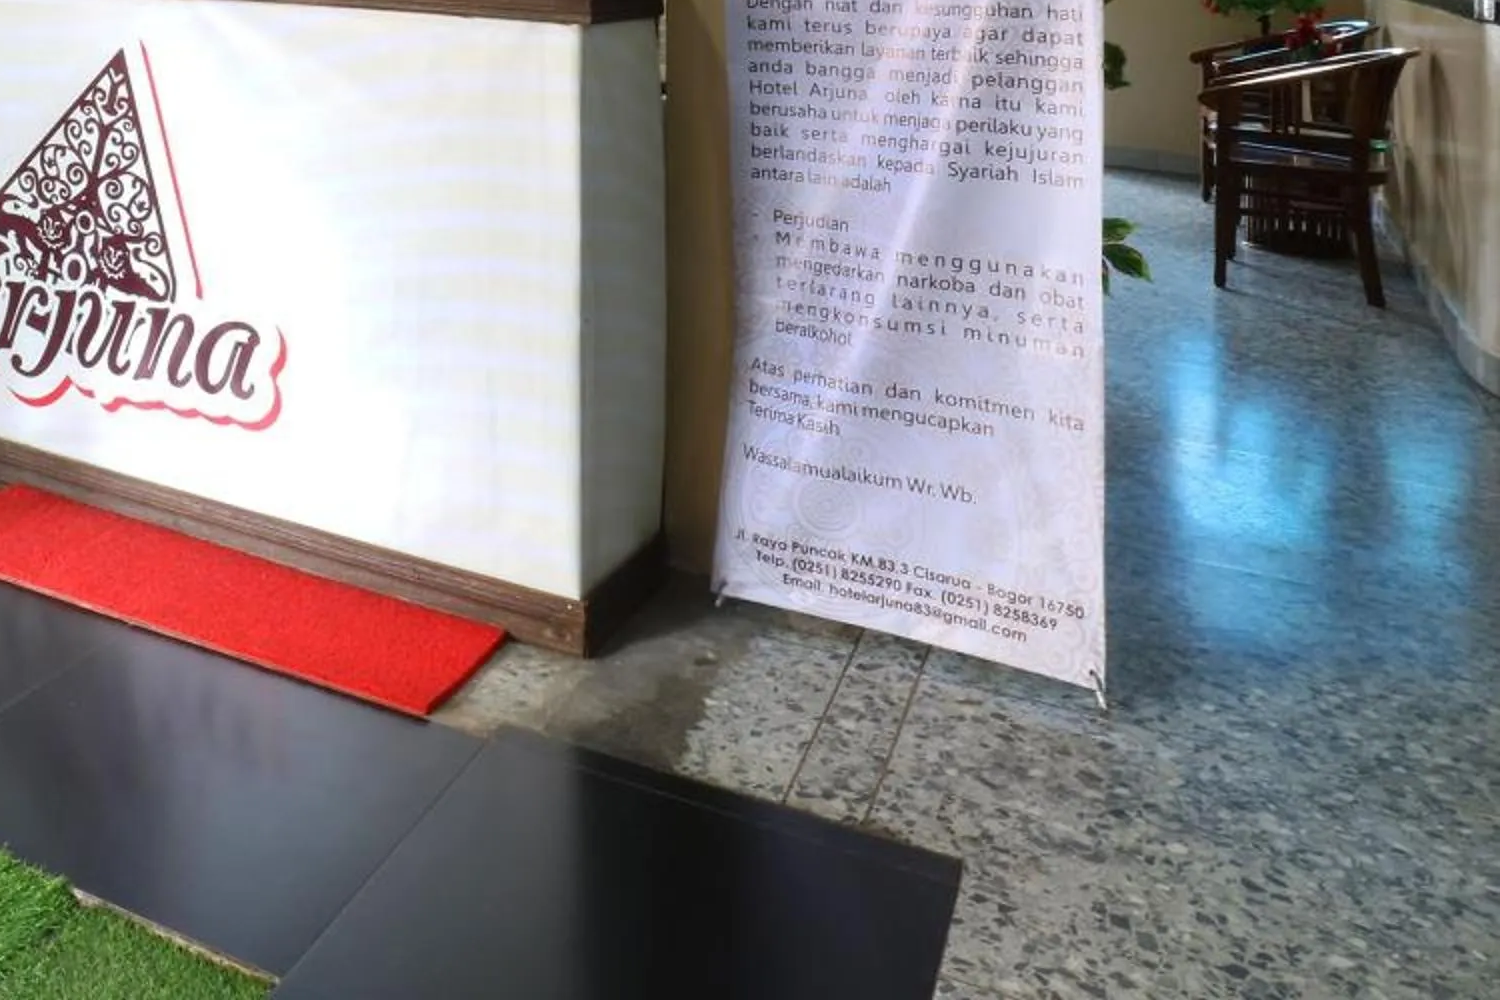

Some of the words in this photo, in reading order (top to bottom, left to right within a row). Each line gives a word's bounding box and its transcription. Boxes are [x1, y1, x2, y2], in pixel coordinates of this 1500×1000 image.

[746, 15, 792, 31] kami
[804, 19, 853, 35] terus
[1021, 26, 1084, 46] dapat
[1047, 3, 1083, 22] hati
[747, 38, 855, 57] memberikan
[995, 49, 1084, 73] sehingga
[747, 59, 793, 74] anda
[805, 60, 876, 82] bangga
[971, 72, 1084, 95] pelanggan
[749, 79, 798, 97] Hotel
[884, 87, 921, 105] oleh
[995, 94, 1021, 112] itu
[1035, 98, 1084, 118] kami
[749, 102, 828, 119] berusaha
[831, 108, 879, 123] untuk
[955, 118, 1033, 137] perilaku
[1037, 124, 1084, 146] yang
[750, 122, 789, 137] baik
[801, 128, 849, 143] serta
[861, 132, 971, 157] menghargai
[985, 141, 1084, 165] kejujuran
[750, 144, 868, 168] berlandaskan
[947, 161, 1019, 183] Syariah
[1033, 168, 1084, 189] Islam
[750, 166, 805, 183] antara
[773, 208, 850, 232] Perjudian
[895, 251, 1085, 286] menggunakan
[776, 275, 876, 309] terlarang
[1016, 311, 1084, 334] serta
[896, 273, 976, 294] narkoba
[989, 280, 1027, 301] dan
[1039, 288, 1085, 310] obat
[963, 326, 1086, 358] minuman
[750, 357, 785, 378] Atas
[885, 382, 922, 401] dan
[934, 388, 1035, 421] komitmen
[1049, 408, 1085, 431] kita
[748, 400, 794, 426] Terima
[797, 413, 841, 436] Kasih
[862, 403, 995, 438] mengucapkan
[742, 442, 902, 490] Wassalamualaikum
[752, 533, 788, 551] Raya
[791, 540, 846, 561] Puncak
[913, 565, 972, 590] Cisarua
[987, 583, 1033, 606] Bogor
[1040, 596, 1086, 620] 16750
[792, 557, 837, 580] (0251)
[841, 567, 902, 592] 8255290
[941, 589, 990, 616] (0251)
[993, 604, 1059, 631] 8258369
